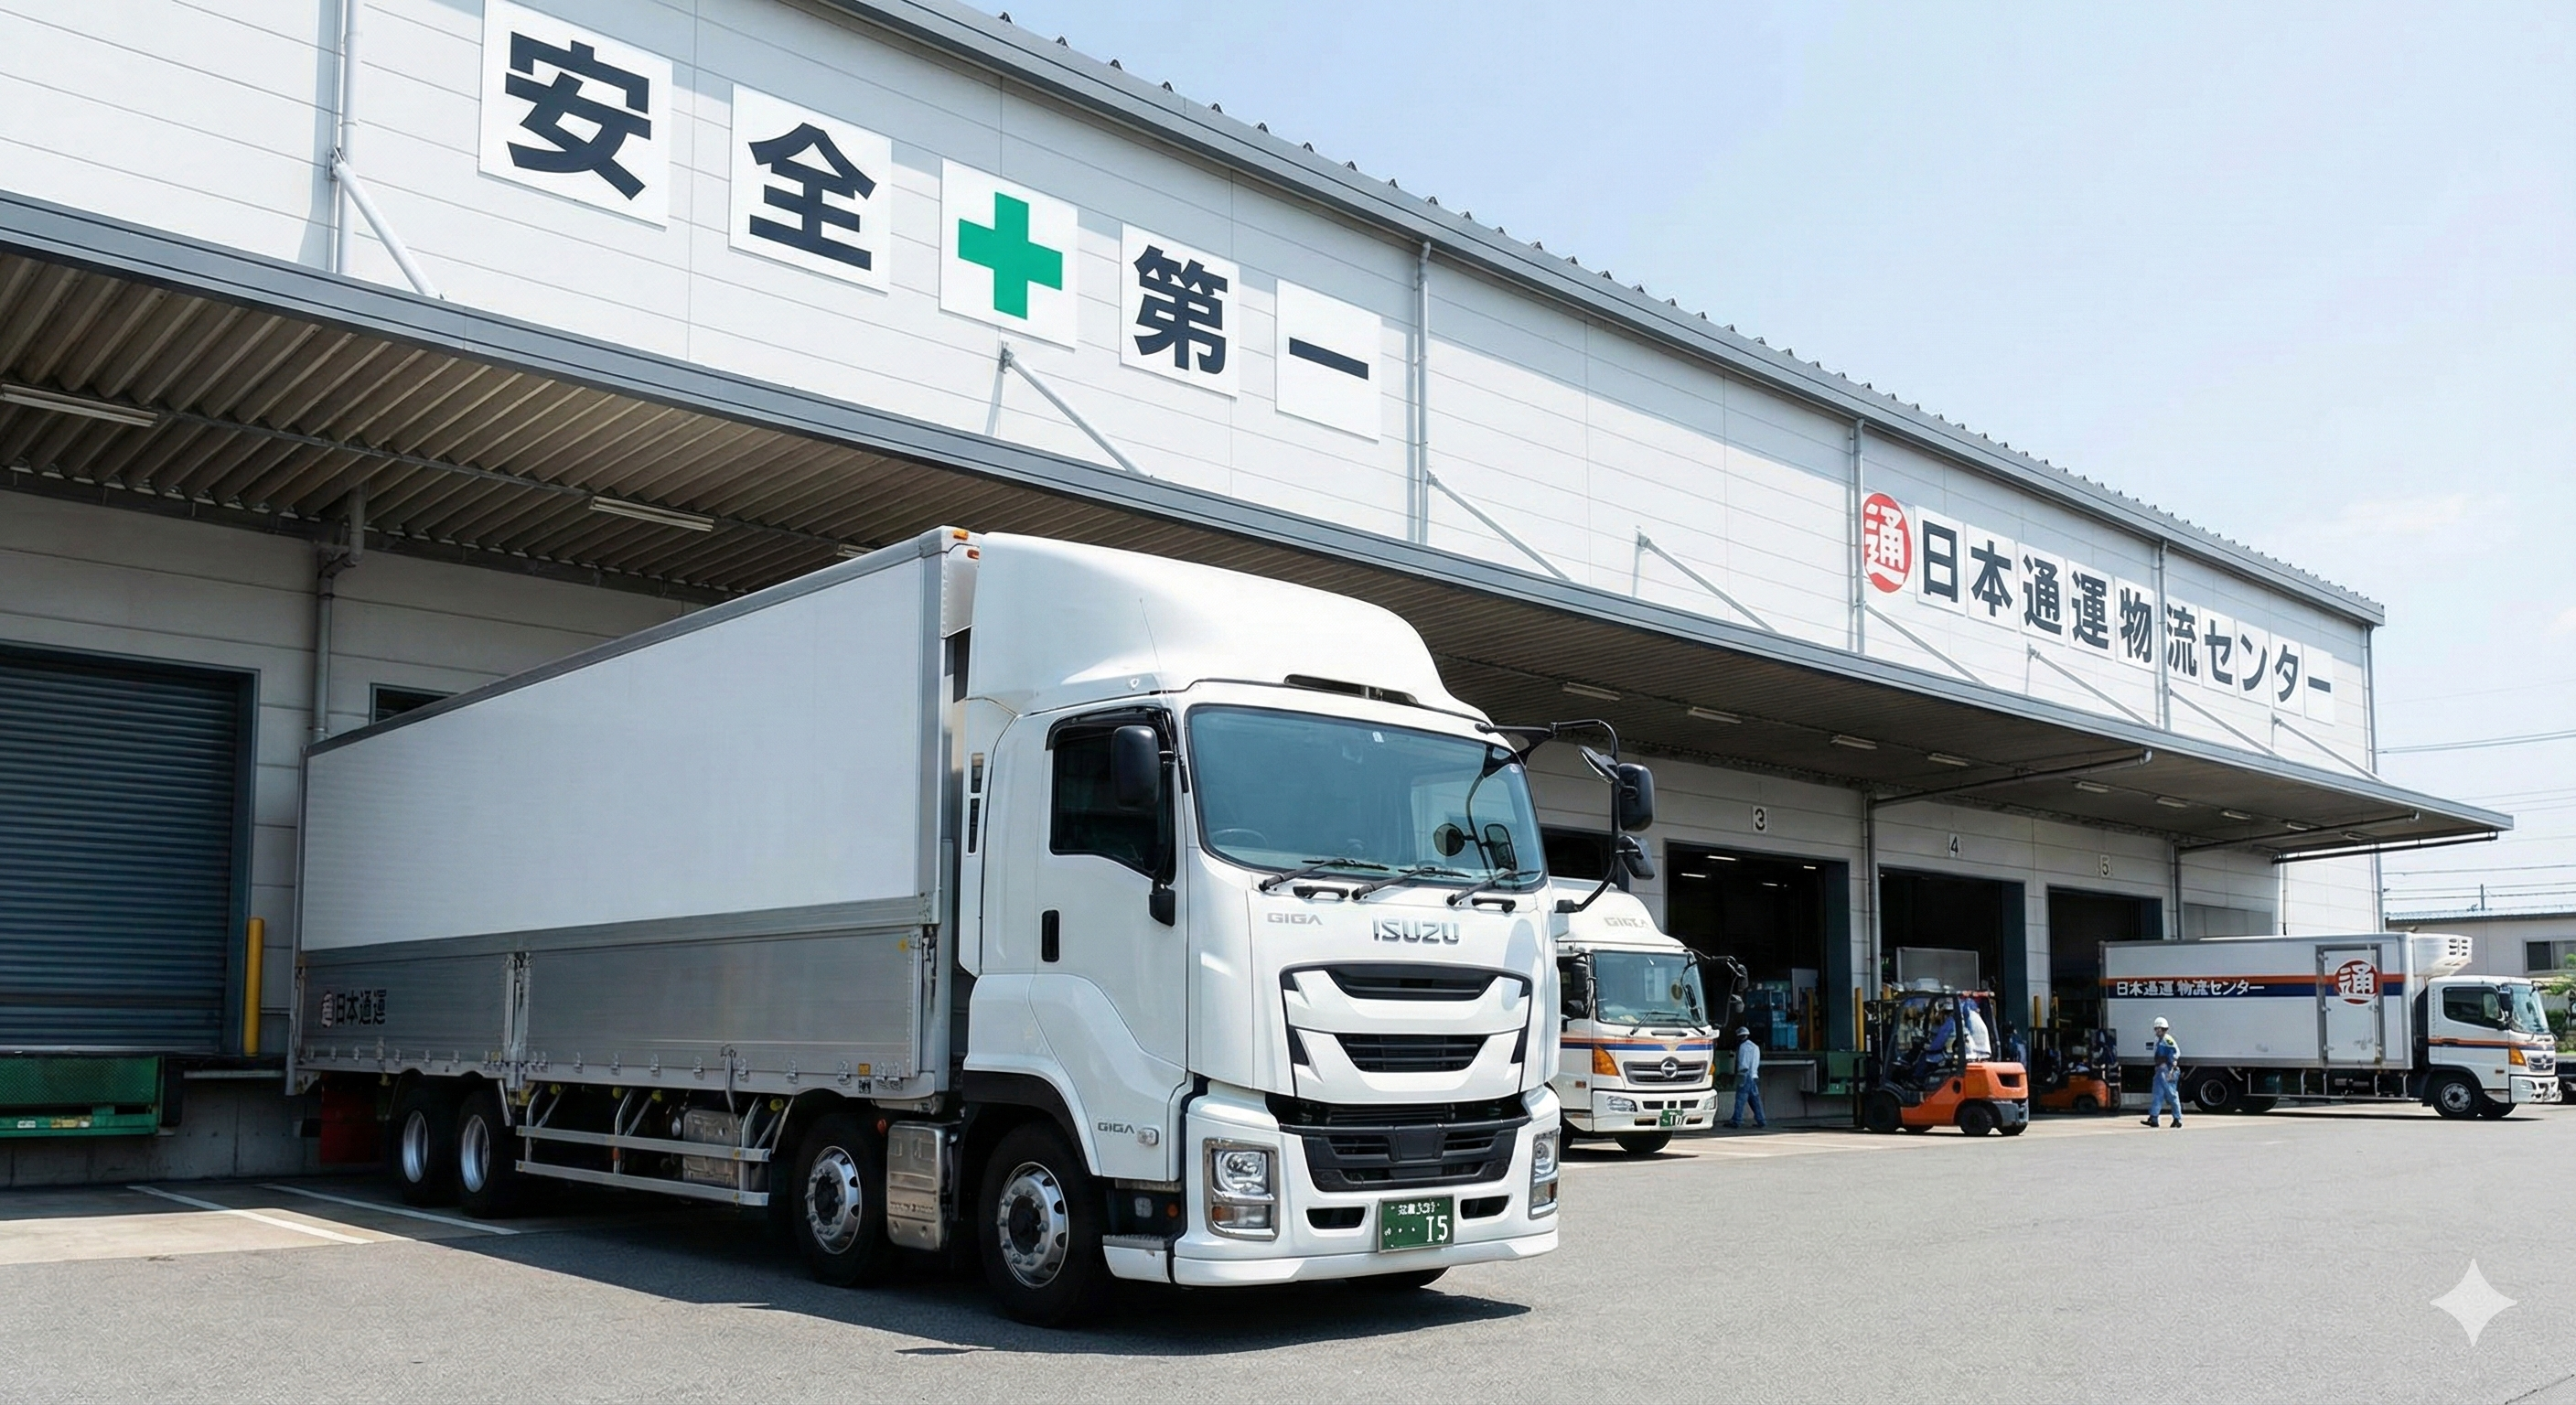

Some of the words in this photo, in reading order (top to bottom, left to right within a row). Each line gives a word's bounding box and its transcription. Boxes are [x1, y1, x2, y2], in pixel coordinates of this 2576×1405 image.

[505, 31, 877, 272] 安全
[1133, 245, 1368, 381] 第一
[1864, 500, 1908, 587] 通
[1922, 519, 2332, 703] 日本通運物流センター
[1755, 808, 1766, 831] 3
[1950, 835, 1959, 853] 4
[1267, 913, 1323, 926] GIGA
[1373, 917, 1459, 945] ISUZU
[1098, 1121, 1135, 1134] GIGA
